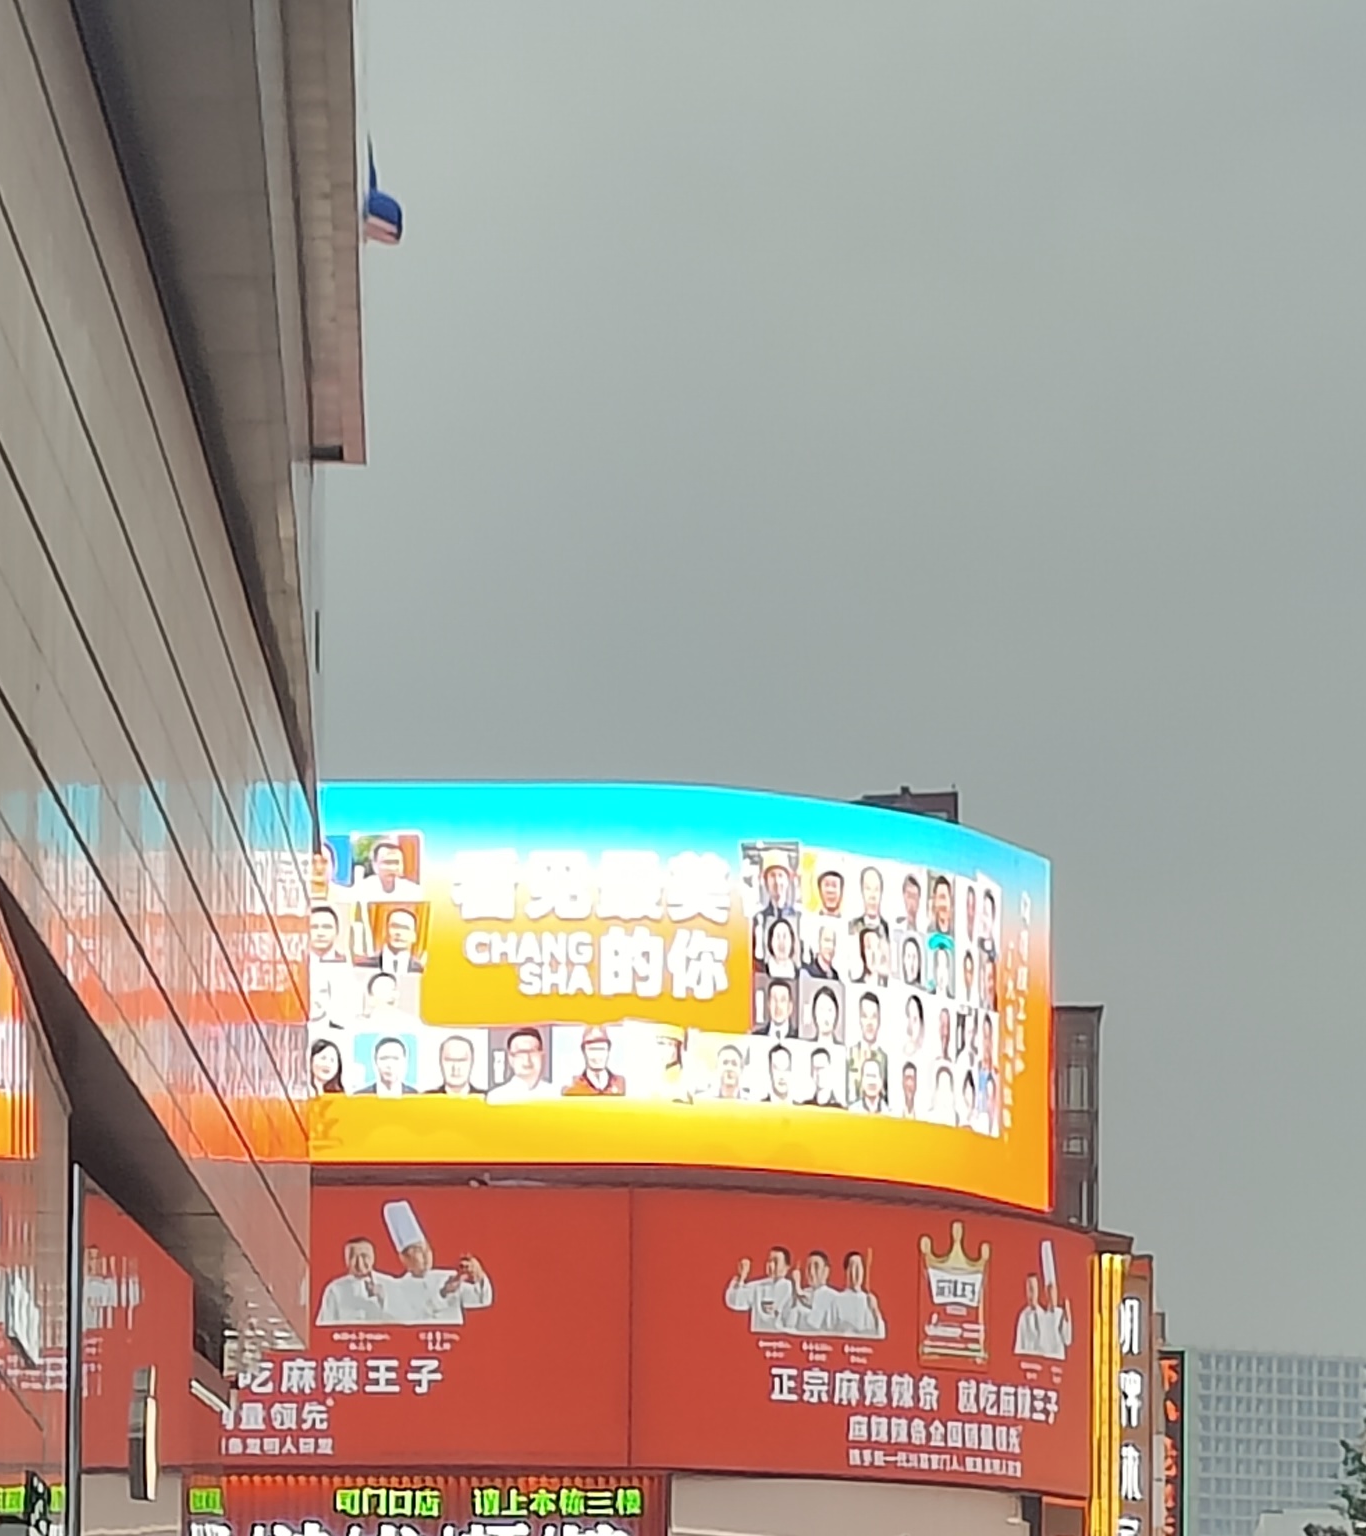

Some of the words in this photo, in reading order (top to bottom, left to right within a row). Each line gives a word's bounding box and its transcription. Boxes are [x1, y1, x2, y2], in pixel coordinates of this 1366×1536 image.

[464, 930, 593, 966] CHANG
[599, 925, 730, 1001] 的你
[517, 962, 595, 996] SHA
